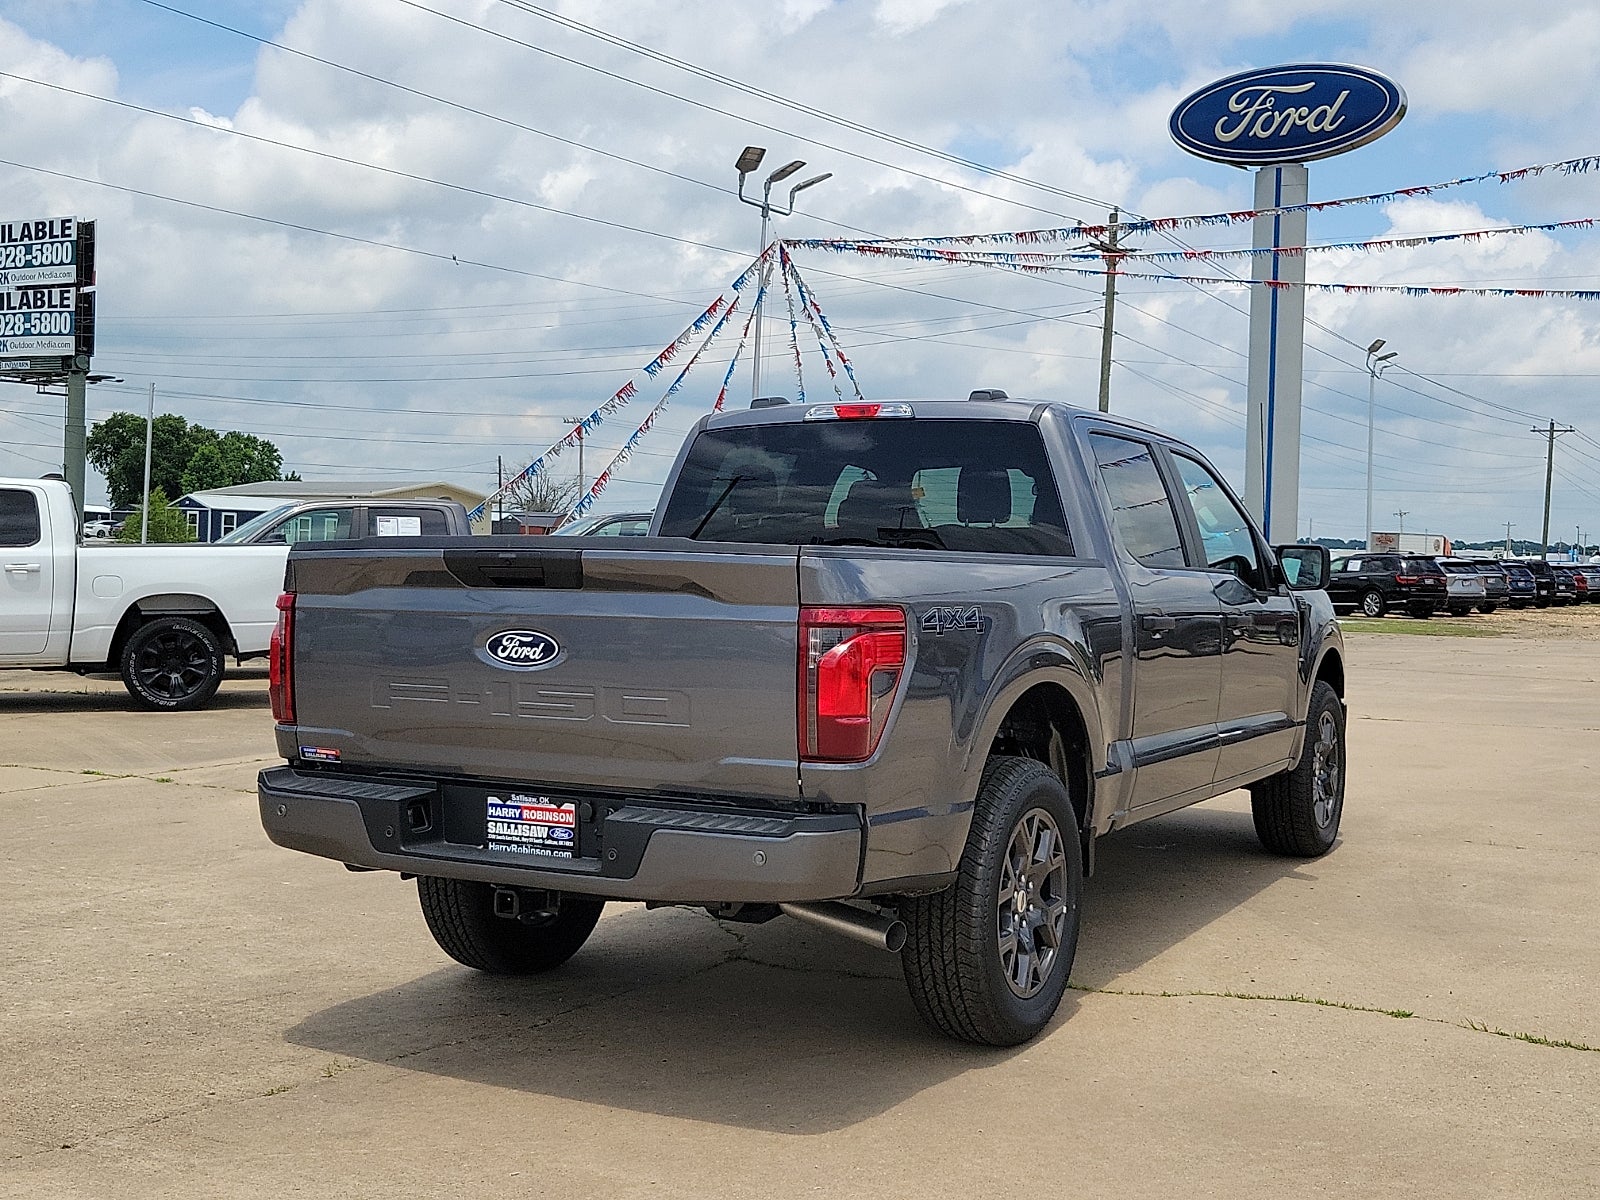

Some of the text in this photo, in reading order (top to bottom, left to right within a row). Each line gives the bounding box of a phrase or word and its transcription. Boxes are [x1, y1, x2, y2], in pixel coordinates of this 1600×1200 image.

[1215, 81, 1350, 142] Ford
[11, 273, 37, 283] Outdoor
[38, 270, 73, 281] Media.com
[10, 341, 35, 350] Outdoor
[36, 340, 71, 349] Media.com
[496, 634, 544, 661] Ford
[370, 674, 691, 729] F-150
[488, 806, 573, 823] HARRY ROBINSON
[487, 821, 549, 838] SALLISAW
